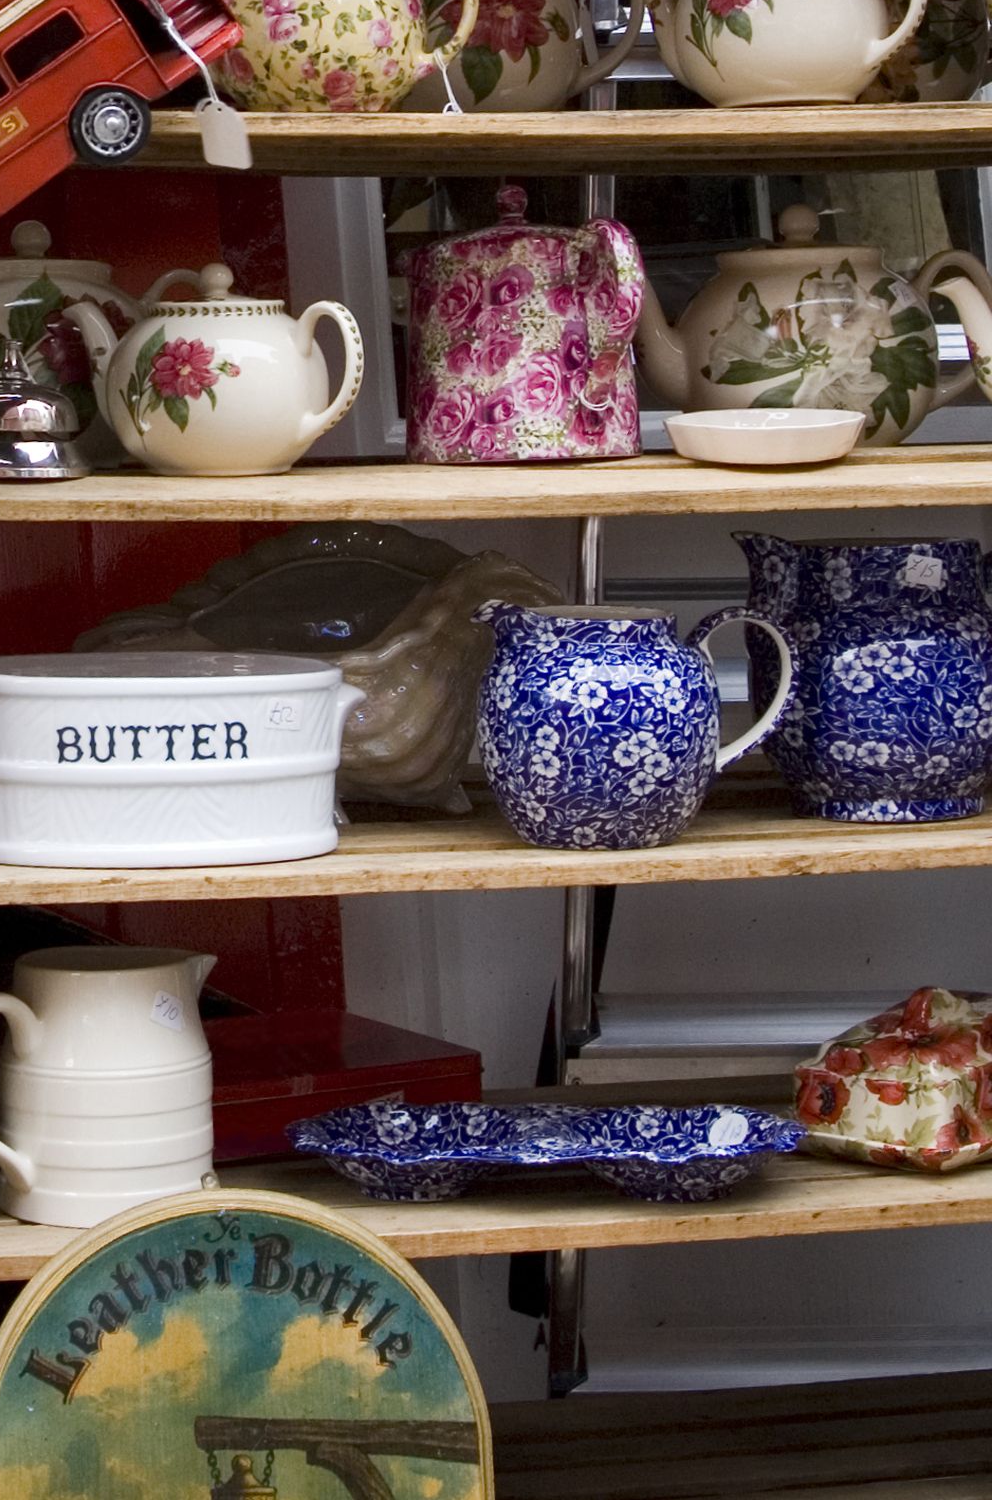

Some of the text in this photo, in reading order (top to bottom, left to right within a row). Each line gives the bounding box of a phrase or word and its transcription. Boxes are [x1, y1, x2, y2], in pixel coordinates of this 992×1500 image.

[906, 558, 939, 579] £15
[56, 721, 249, 764] BUTTER
[204, 1213, 241, 1242] Ye
[18, 1233, 414, 1406] Leather Bottle
